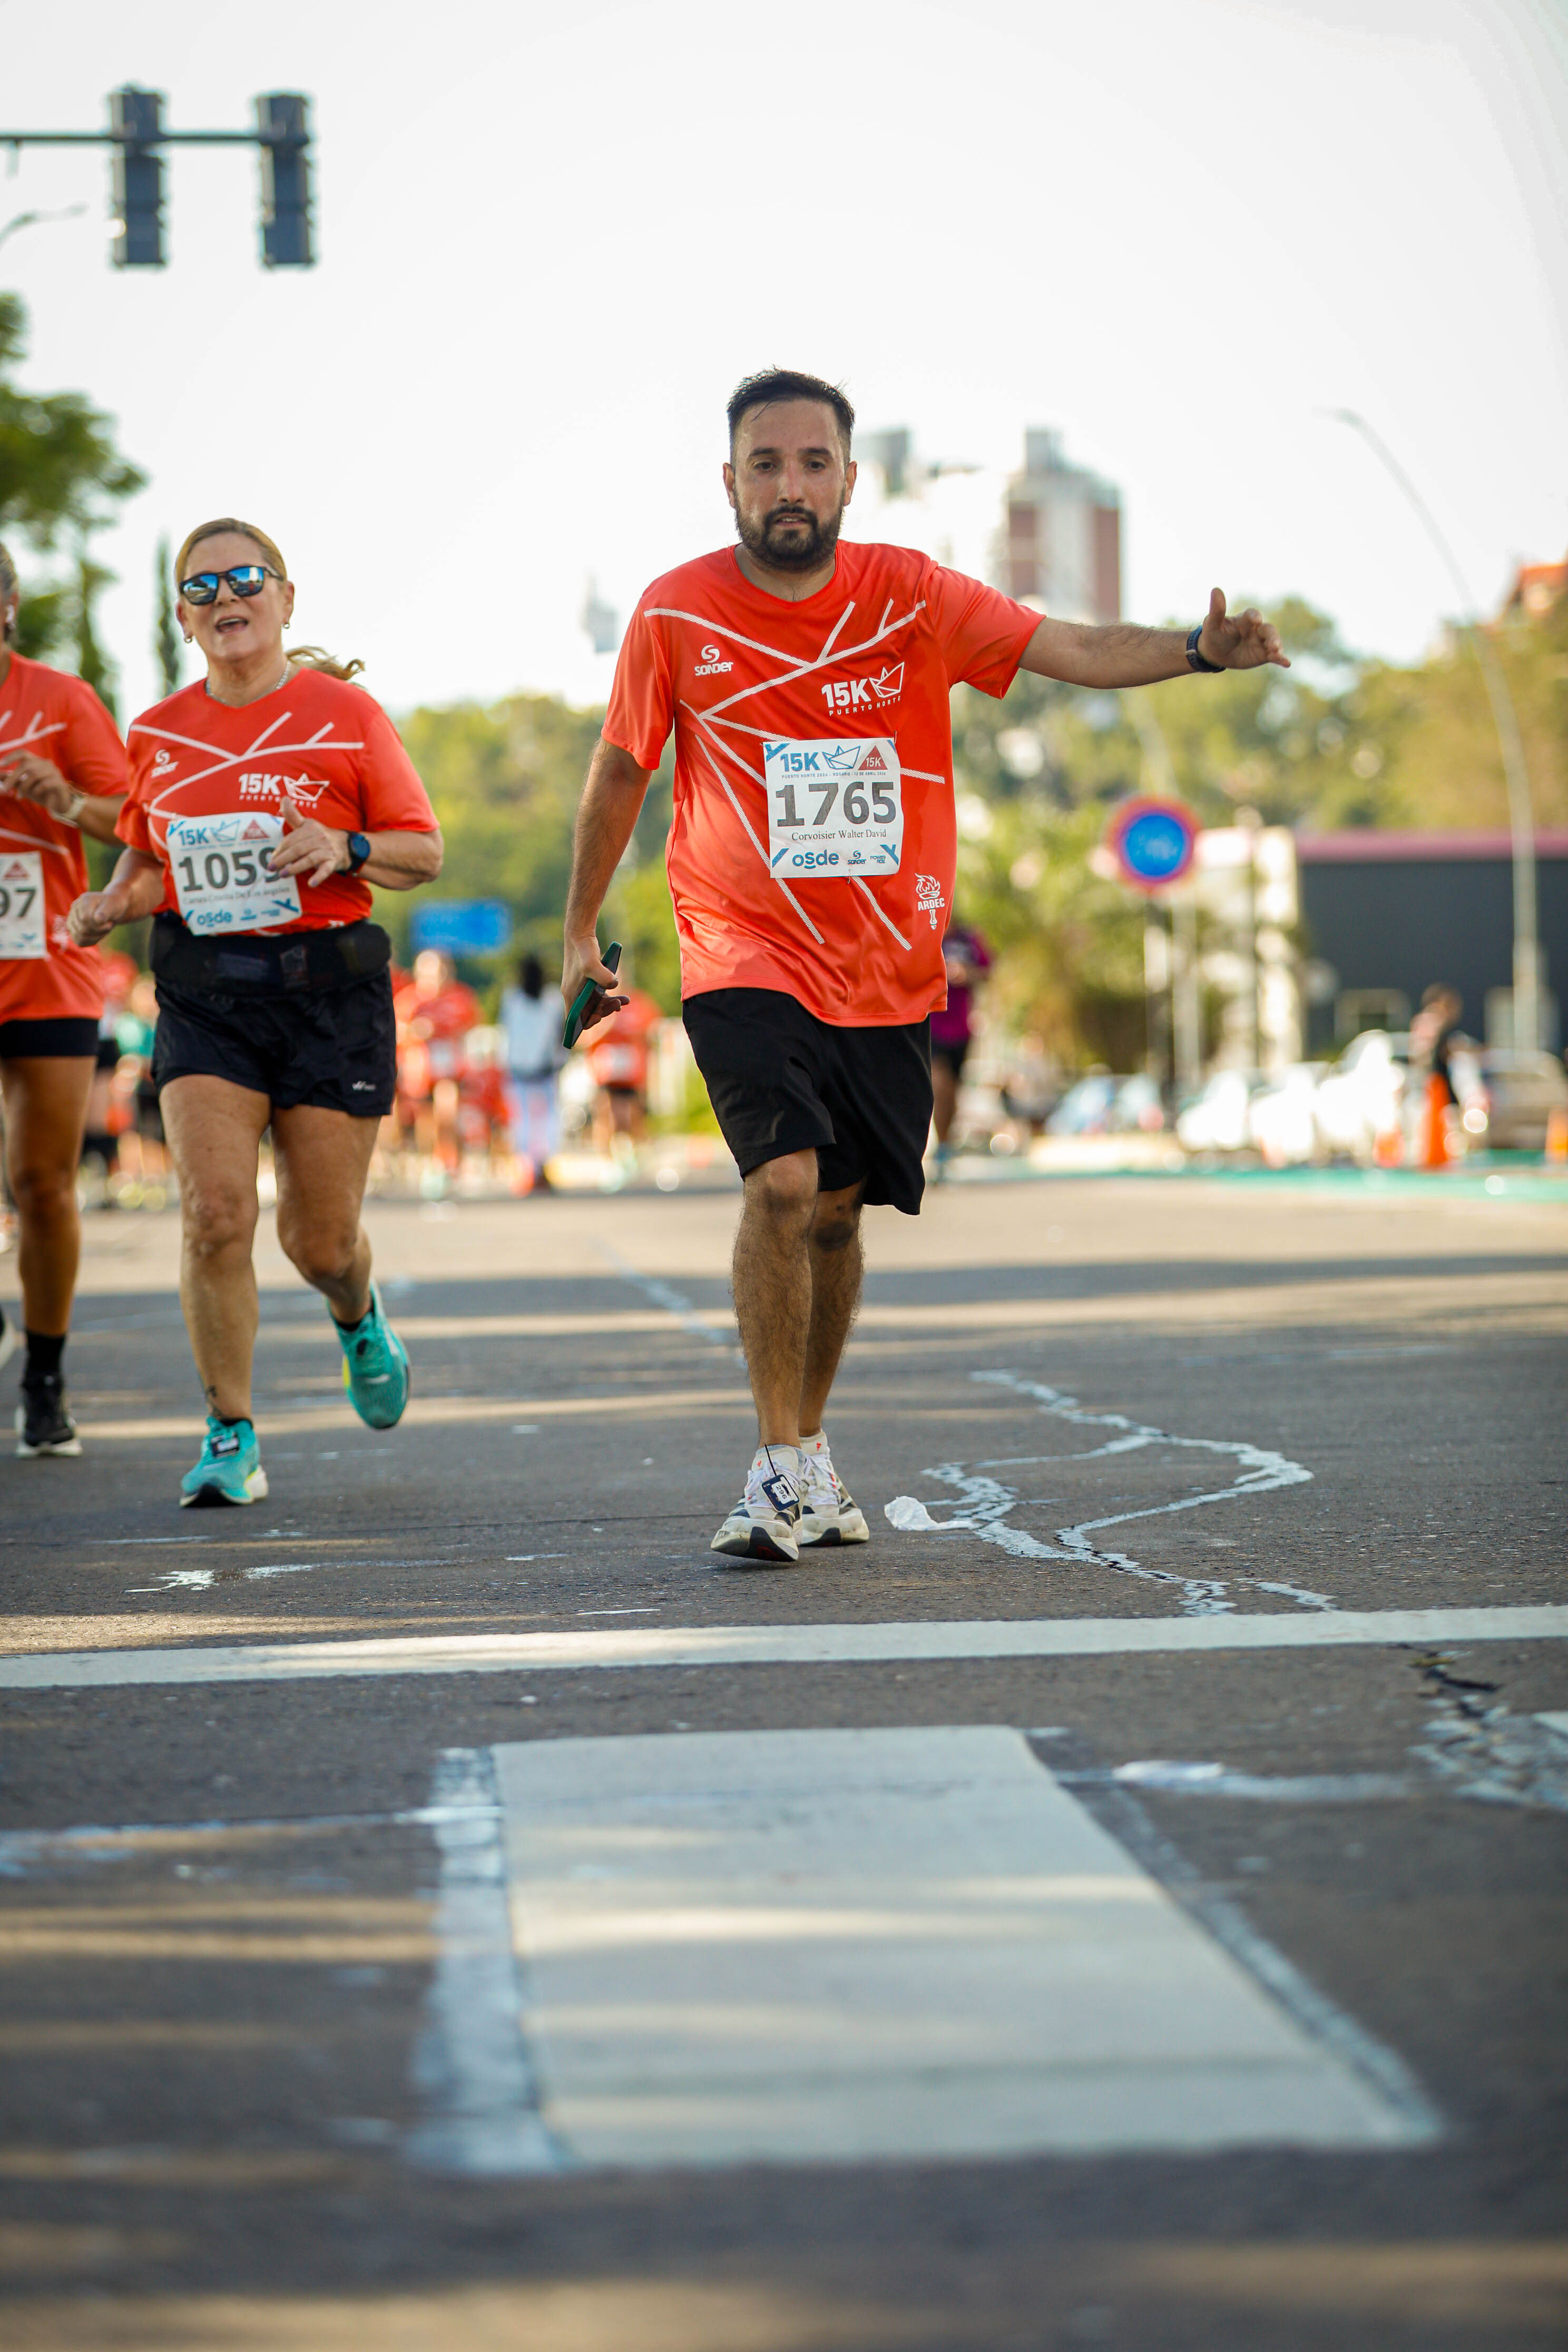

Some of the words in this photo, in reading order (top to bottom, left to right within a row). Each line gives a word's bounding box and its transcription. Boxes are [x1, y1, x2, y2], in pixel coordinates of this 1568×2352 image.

[821, 678, 871, 708] 15K
[829, 704, 872, 717] PUERTO
[877, 695, 901, 709] NORTE
[780, 752, 820, 772] 15K
[866, 757, 881, 768] 15K
[239, 773, 282, 795] 15K
[775, 781, 896, 827] 1765
[179, 827, 210, 846] 15K
[791, 830, 836, 841] Corvoisier
[838, 830, 864, 839] Walter
[866, 829, 887, 838] David
[792, 849, 839, 867] osde
[917, 897, 945, 911] ARDEC
[197, 908, 233, 926] osde
[775, 1485, 788, 1500] 296
